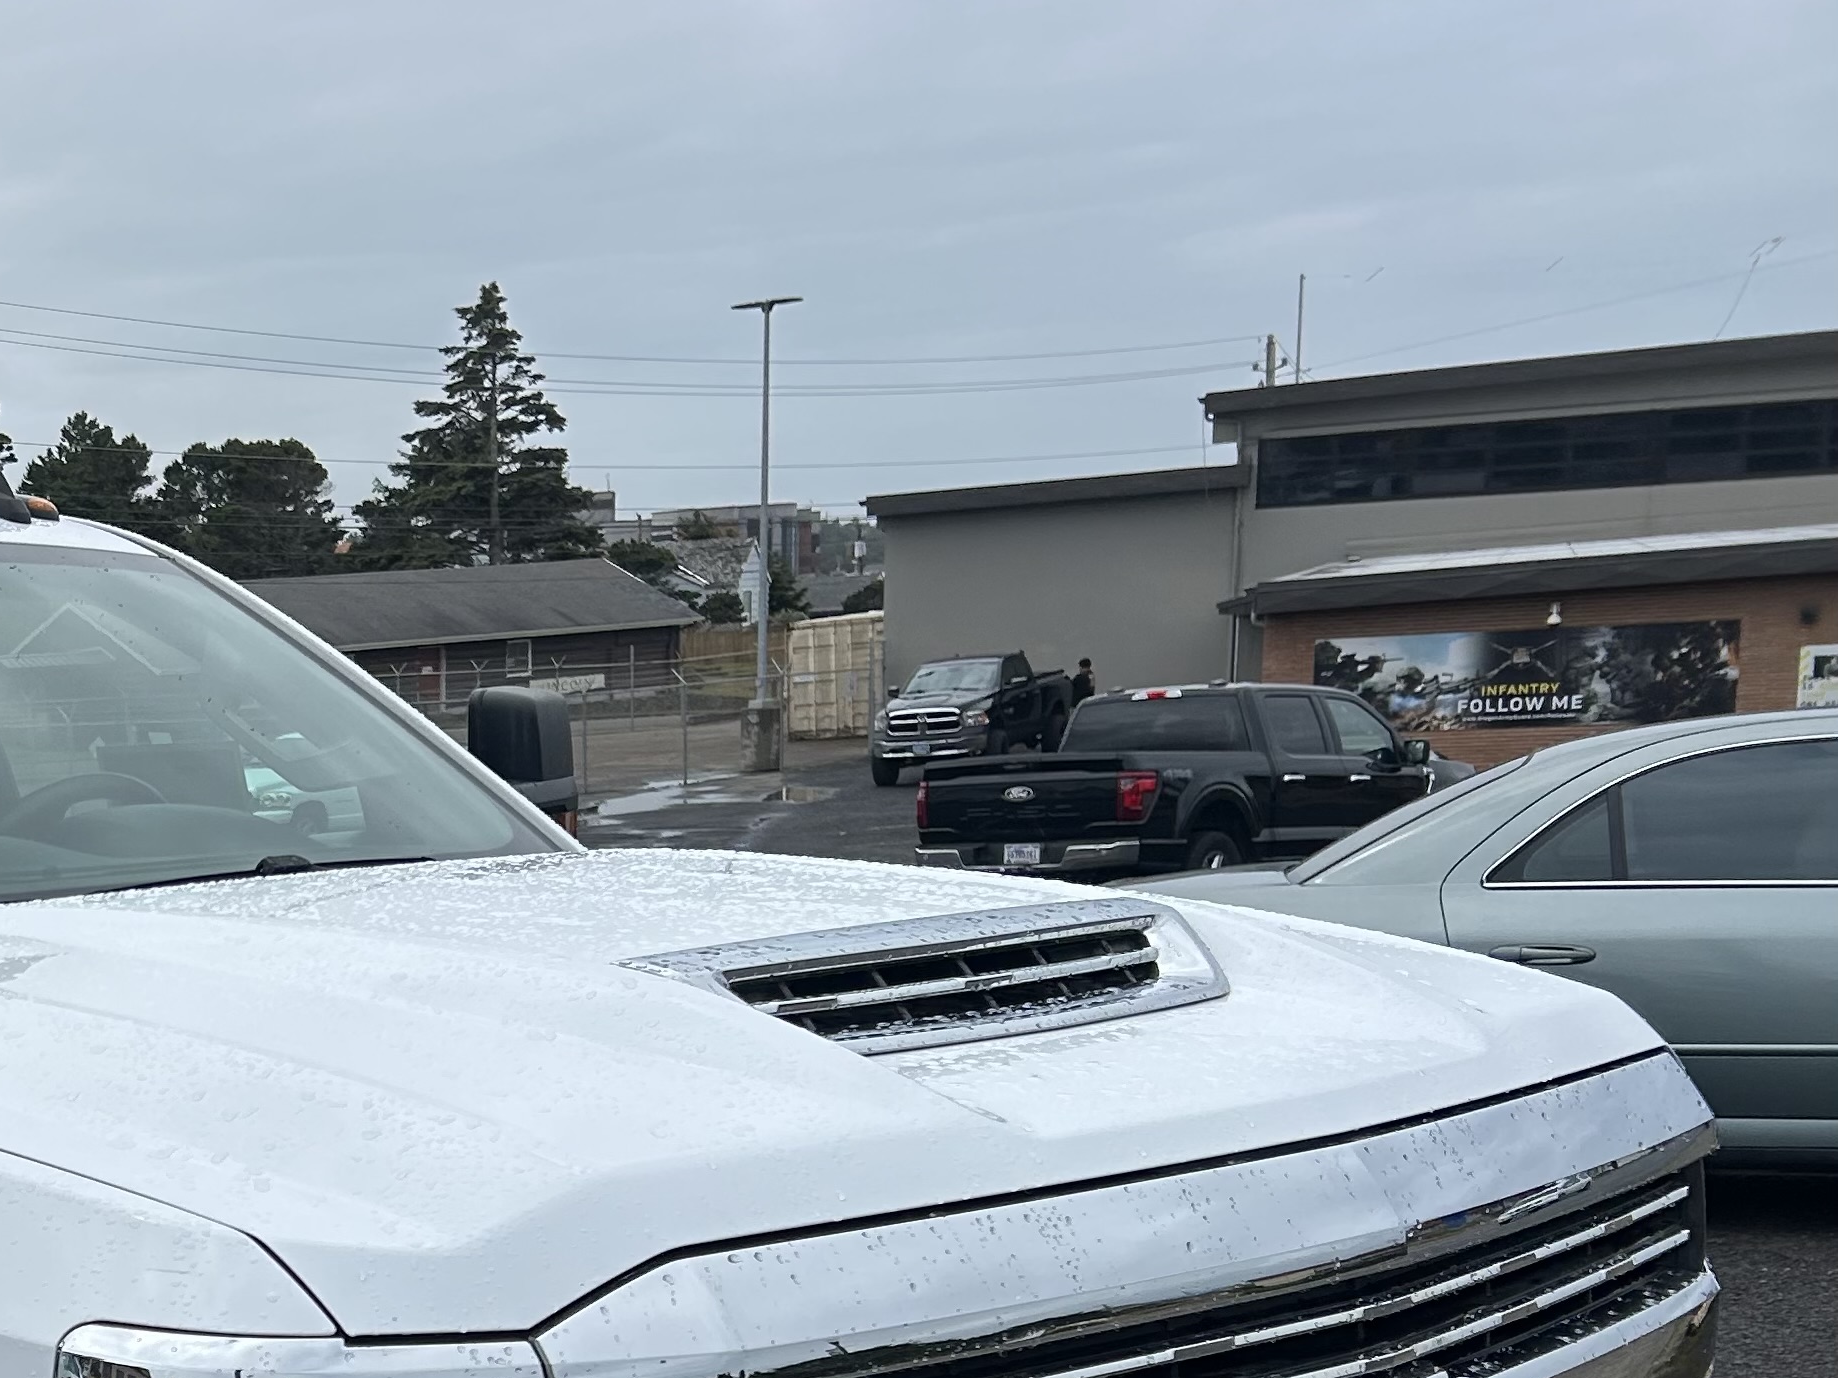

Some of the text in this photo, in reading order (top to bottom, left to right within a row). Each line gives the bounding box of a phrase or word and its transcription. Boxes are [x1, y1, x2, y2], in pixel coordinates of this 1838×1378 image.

[1481, 681, 1560, 697] INFANTRY
[1457, 694, 1584, 714] FOLLOW ME
